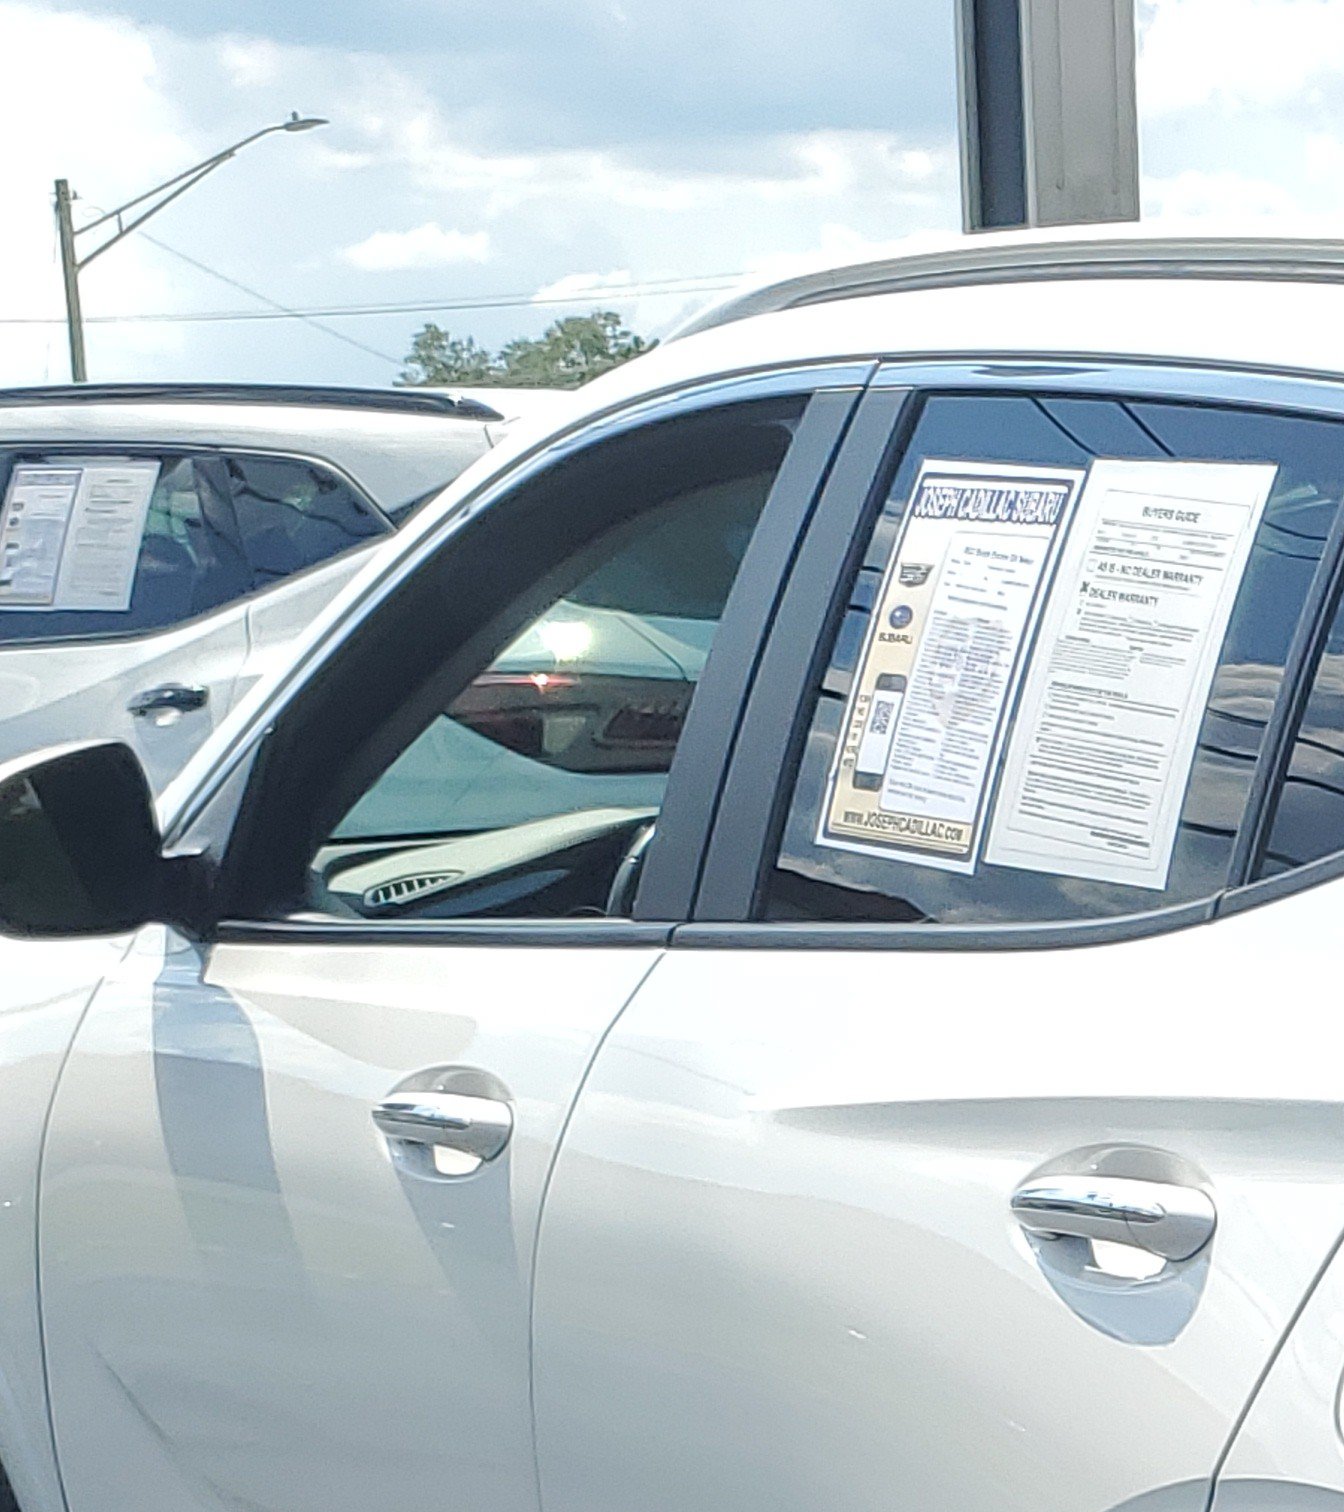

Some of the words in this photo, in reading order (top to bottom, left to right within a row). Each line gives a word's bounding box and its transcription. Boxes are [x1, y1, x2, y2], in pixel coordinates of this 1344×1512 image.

[914, 487, 961, 517] JOSEPH
[959, 488, 1015, 521] CADILLAC
[1012, 490, 1063, 524] SUBARU
[1174, 510, 1202, 524] GUIDE
[1097, 561, 1108, 571] AS
[1133, 565, 1162, 579] DEALER
[1161, 570, 1204, 586] WARRANTY
[1088, 587, 1117, 601] DEALER
[1117, 591, 1159, 607] WARRANTY
